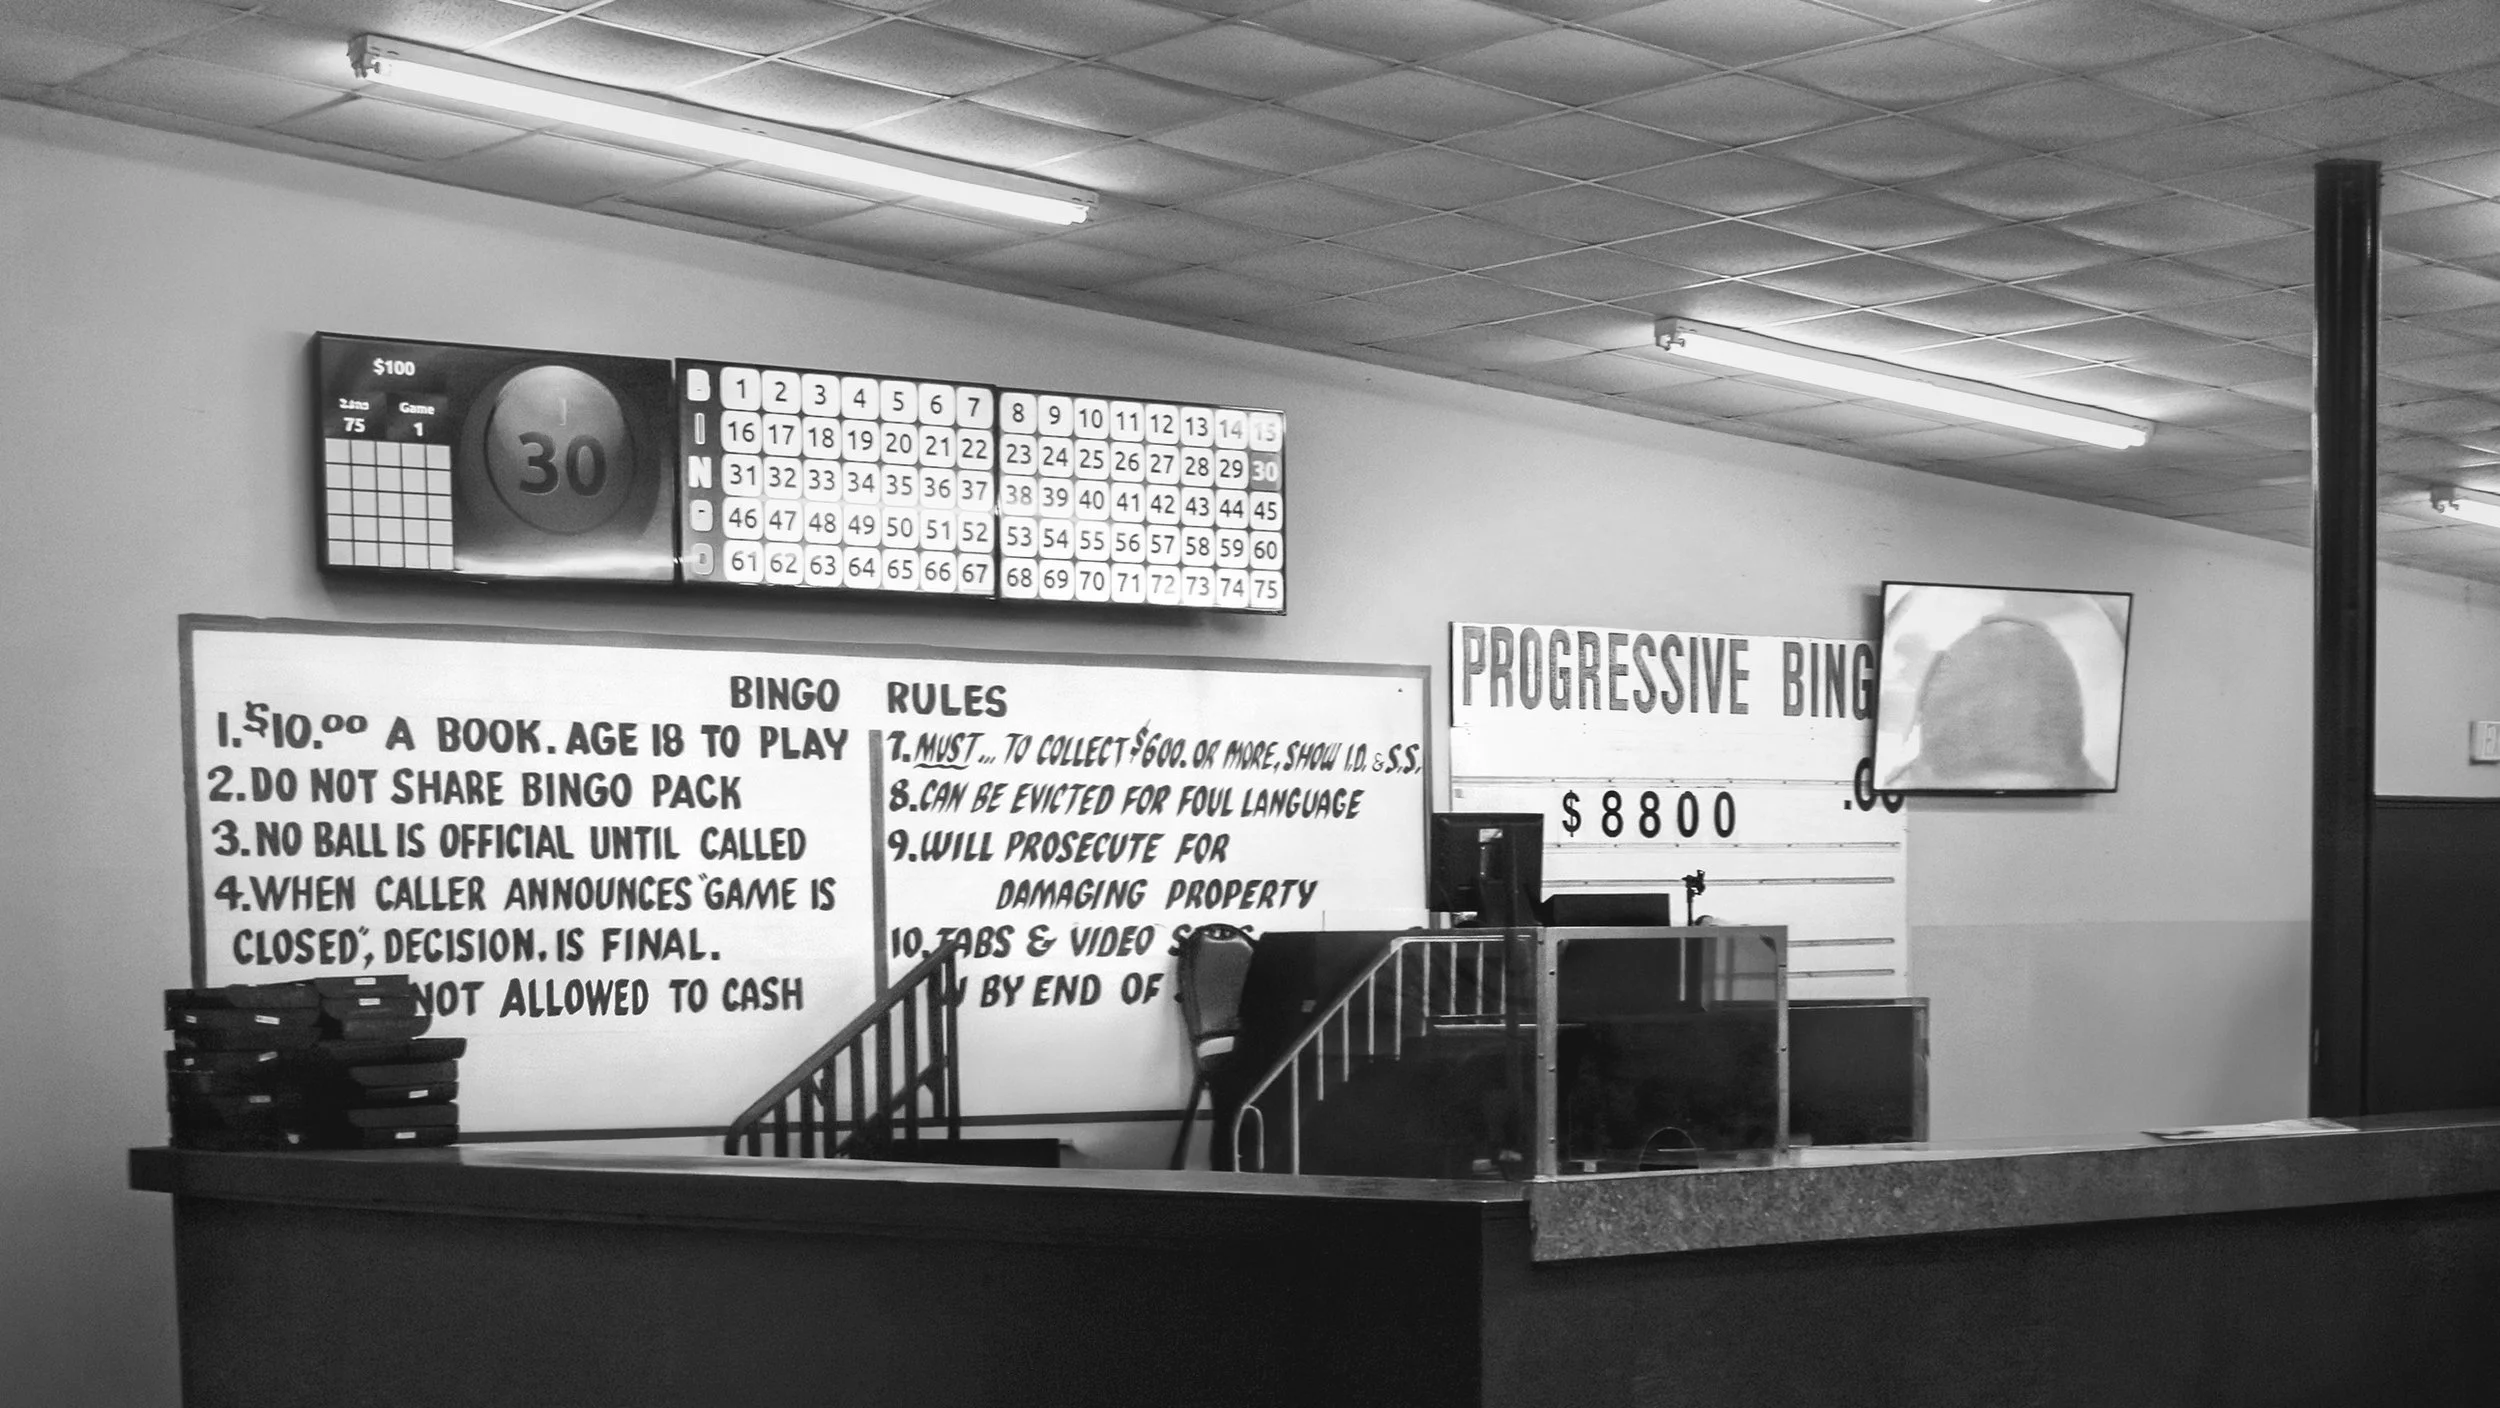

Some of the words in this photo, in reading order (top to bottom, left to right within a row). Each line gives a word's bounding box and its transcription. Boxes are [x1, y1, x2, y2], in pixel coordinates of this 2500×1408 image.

[373, 358, 416, 376] $100
[343, 417, 366, 433] 75
[413, 422, 424, 437] 1
[399, 402, 435, 415] Game
[735, 379, 745, 399] 1
[774, 381, 787, 402] 2
[814, 384, 826, 405] 3
[852, 389, 866, 408] 4
[892, 391, 904, 411] 5
[929, 395, 942, 414] 6
[967, 397, 980, 417] 7
[1012, 403, 1024, 423] 8
[1048, 405, 1061, 425] 9
[1078, 409, 1103, 428] 10
[1115, 412, 1137, 431] 11
[1150, 414, 1174, 434] 12
[1185, 417, 1208, 436] 13
[1218, 419, 1242, 439] 14
[727, 421, 755, 442] 16
[767, 424, 795, 445] 17
[807, 427, 834, 448] 18
[847, 430, 873, 450] 19
[885, 433, 912, 453] 20
[925, 436, 949, 456] 21
[961, 438, 987, 459] 22
[1005, 443, 1031, 464] 23
[1042, 446, 1068, 467] 24
[1079, 449, 1104, 469] 25
[1114, 451, 1139, 471] 26
[1149, 454, 1174, 474] 27
[1184, 456, 1209, 476] 28
[1219, 459, 1243, 478] 29
[1252, 460, 1279, 482] 30
[519, 432, 607, 537] 30
[729, 464, 755, 485] 31
[768, 466, 796, 488] 32
[808, 469, 835, 490] 33
[847, 472, 875, 493] 34
[886, 474, 912, 495] 35
[924, 477, 951, 498] 36
[961, 480, 988, 500] 37
[1005, 484, 1032, 505] 38
[1042, 487, 1068, 507] 39
[1078, 490, 1104, 510] 40
[1116, 492, 1139, 512] 41
[1149, 494, 1175, 514] 42
[1184, 497, 1209, 516] 43
[1218, 499, 1244, 518] 44
[1253, 501, 1277, 520] 45
[728, 508, 757, 528] 46
[768, 510, 796, 530] 47
[808, 513, 836, 533] 48
[847, 515, 875, 535] 49
[886, 517, 913, 537] 50
[926, 520, 949, 540] 51
[961, 522, 988, 542] 52
[1006, 526, 1032, 547] 53
[1043, 528, 1068, 548] 54
[1079, 530, 1104, 550] 55
[1115, 533, 1140, 552] 56
[1150, 534, 1175, 554] 57
[1185, 536, 1210, 556] 58
[1219, 538, 1244, 557] 59
[1253, 541, 1277, 560] 60
[730, 550, 756, 571] 61
[769, 553, 797, 574] 62
[809, 555, 836, 575] 63
[848, 557, 875, 577] 64
[887, 559, 912, 579] 65
[924, 561, 951, 581] 66
[961, 563, 988, 583] 67
[1006, 568, 1032, 587] 68
[1043, 570, 1068, 589] 69
[1079, 571, 1104, 591] 70
[1117, 573, 1139, 592] 71
[1151, 574, 1175, 593] 72
[1185, 576, 1209, 596] 73
[1220, 578, 1244, 597] 74
[1253, 580, 1277, 599] 75
[1461, 626, 1749, 715] PROGRESSIVE
[730, 676, 840, 712] BINGO
[888, 682, 1007, 717] RULES
[385, 716, 415, 751] A
[565, 722, 638, 756] AGE
[652, 723, 684, 757] 18
[701, 725, 740, 758] TO
[760, 726, 848, 760] PLAY
[1006, 733, 1032, 763] TO
[1038, 735, 1130, 767] COLLECT
[1193, 739, 1220, 768] OR
[1283, 740, 1340, 771] SHOW
[1372, 753, 1384, 772] &
[310, 768, 378, 804] NOT
[391, 768, 504, 806] SHARE
[522, 772, 632, 807] BINGO
[653, 774, 741, 810] PACK
[970, 781, 1008, 813] BE
[1010, 783, 1115, 815] EVICTED
[1121, 784, 1171, 815] FOR
[1177, 785, 1233, 817] FOUL
[1241, 787, 1365, 819] LANGUAGE
[314, 822, 388, 858] BALL
[397, 823, 425, 858] IS
[440, 823, 574, 859] OFFICIAL
[590, 826, 680, 860] UNTIL
[700, 826, 806, 861] CALLED
[1005, 831, 1165, 863] PROSECUTE
[1174, 833, 1230, 864] FOR
[375, 876, 486, 911] CALLER
[504, 876, 692, 911] ANNOUNCES
[811, 877, 836, 911] IS
[996, 878, 1148, 910] DAMAGING
[1165, 879, 1318, 909] PROPERTY
[557, 928, 584, 962] IS
[602, 928, 720, 962] FINAL.
[1026, 924, 1057, 957] &
[1071, 925, 1155, 957] VIDEO
[412, 981, 485, 1017] NOT
[499, 978, 649, 1018] ALLOWED
[669, 978, 703, 1013] TO
[722, 976, 803, 1012] CASH
[980, 974, 1025, 1008] BY
[1032, 974, 1101, 1007] END
[1121, 973, 1165, 1005] OF
